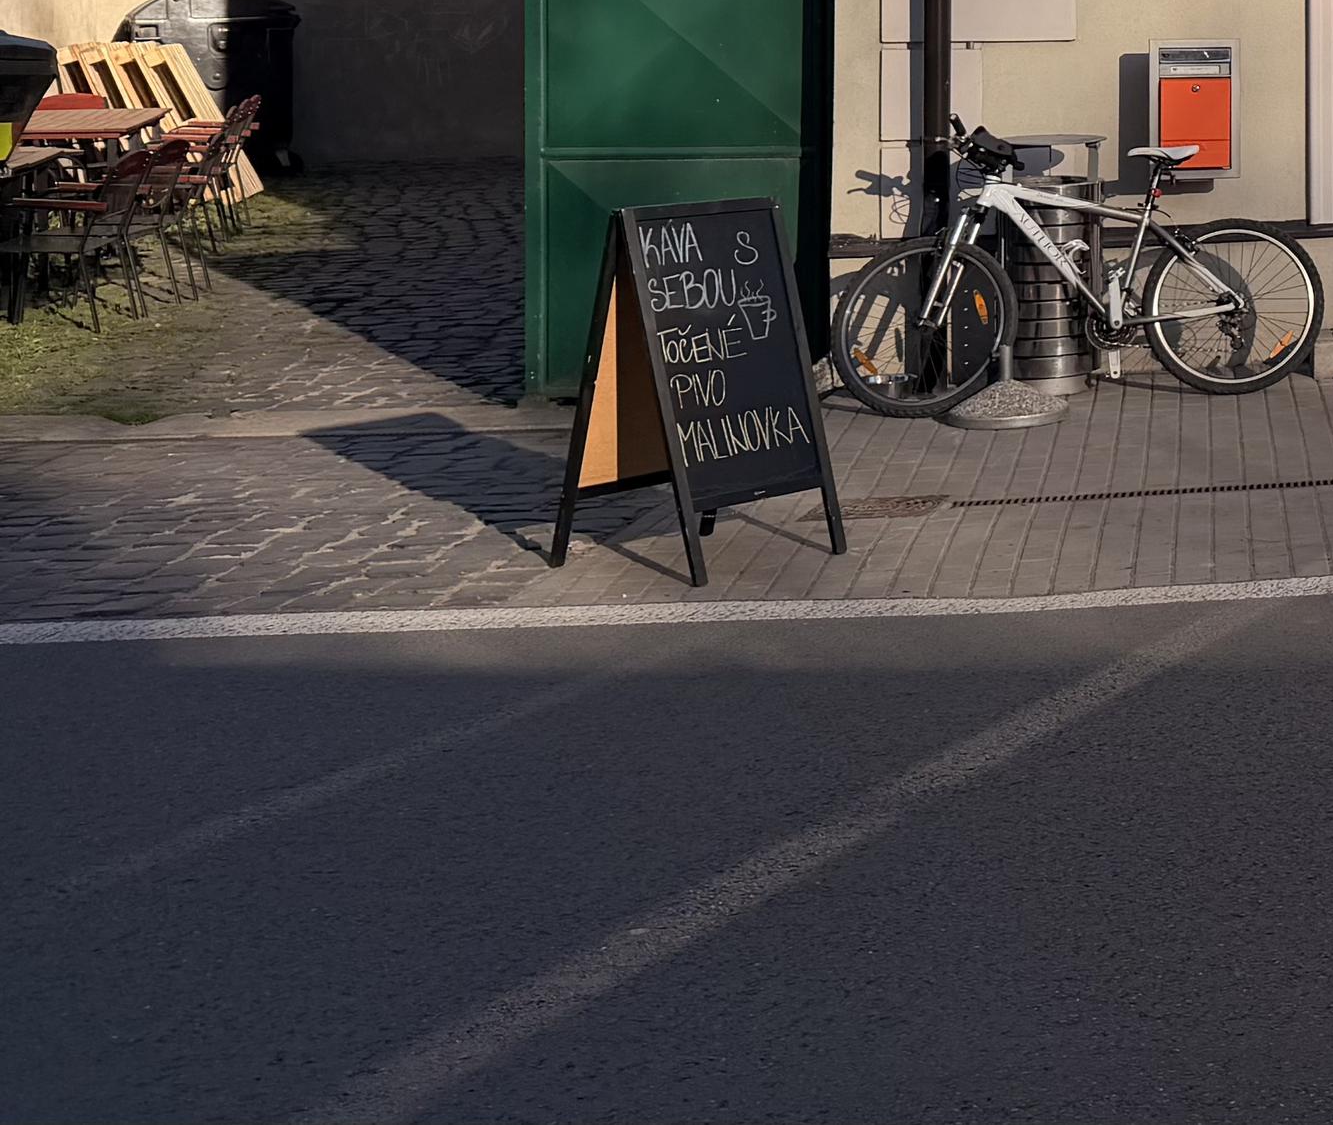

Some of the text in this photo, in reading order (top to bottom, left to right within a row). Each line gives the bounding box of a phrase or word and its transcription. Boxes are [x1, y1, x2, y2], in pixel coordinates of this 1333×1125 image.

[638, 218, 759, 269] KÁVA S
[647, 268, 736, 312] SEBOU
[669, 369, 726, 410] PIVO
[676, 406, 811, 468] MALINOVKA
